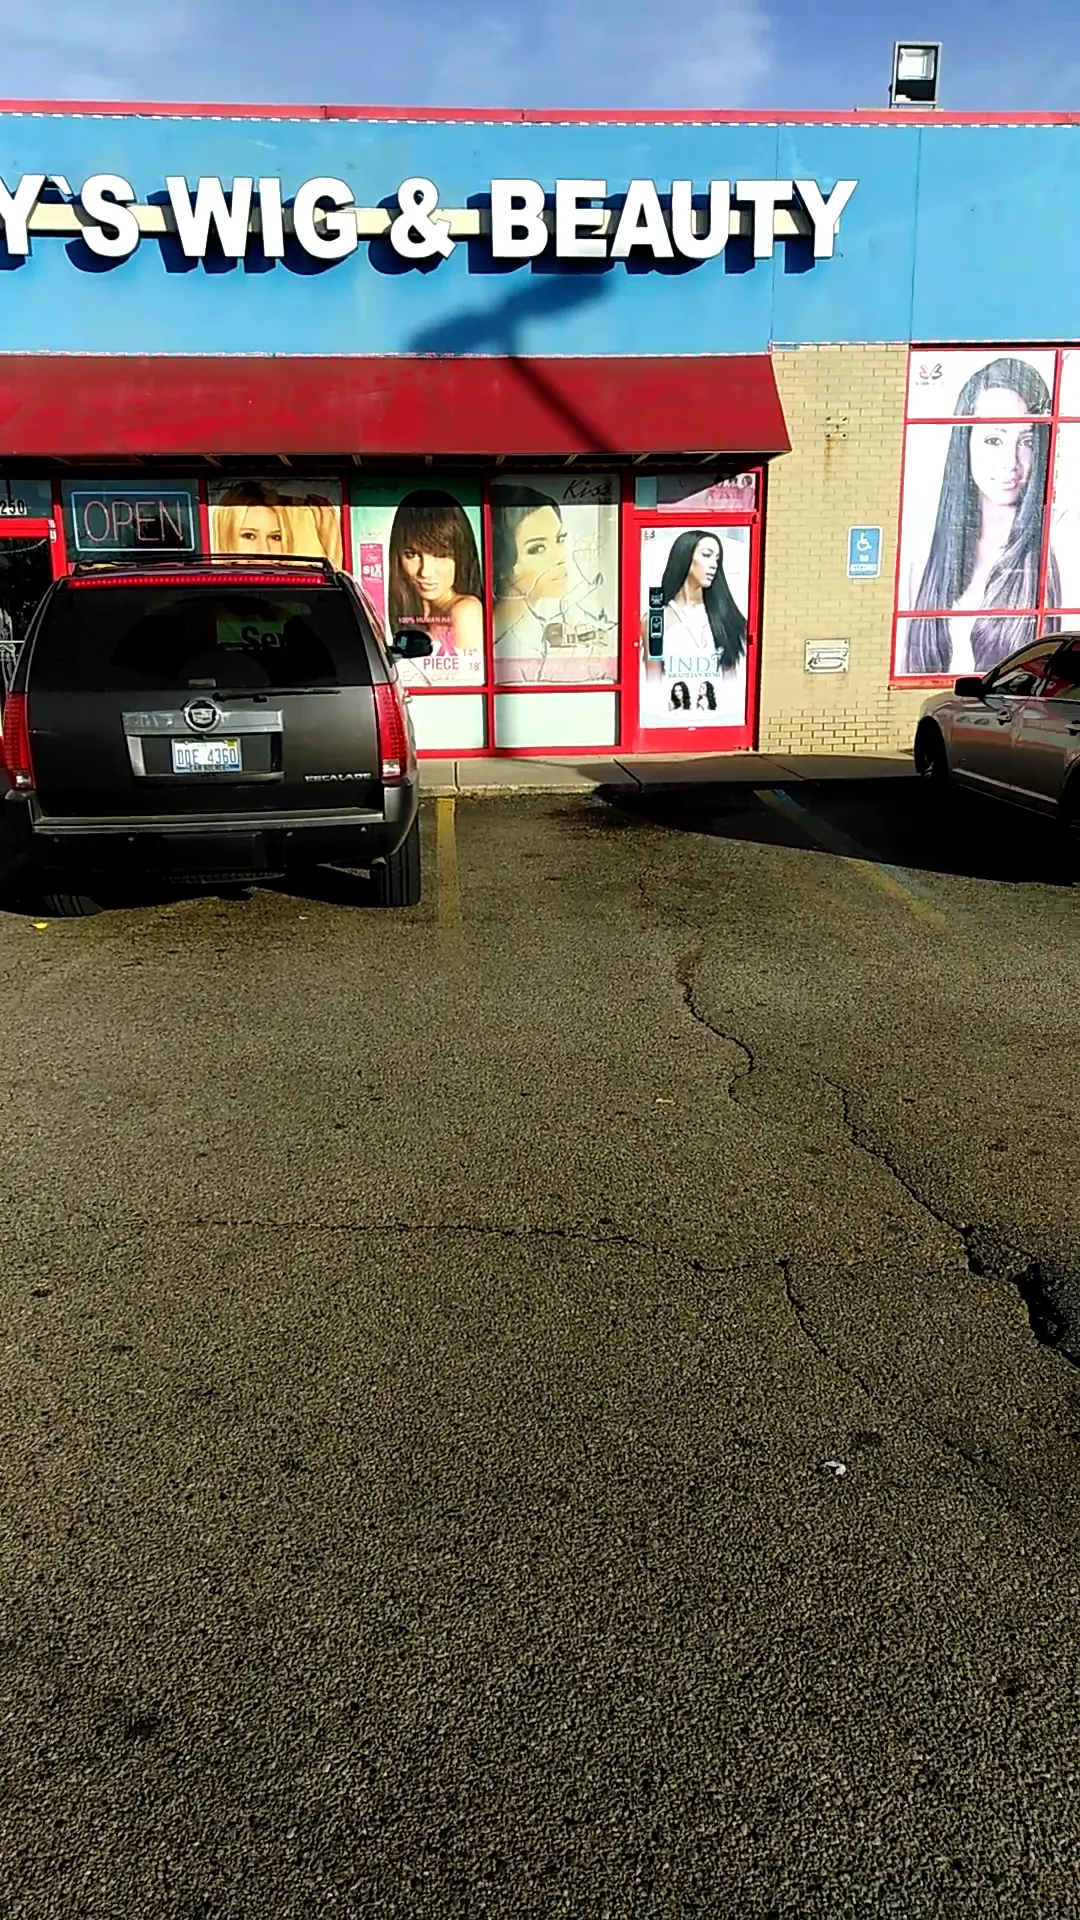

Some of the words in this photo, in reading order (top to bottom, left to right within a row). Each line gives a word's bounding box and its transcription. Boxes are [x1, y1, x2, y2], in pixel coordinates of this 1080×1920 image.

[165, 176, 359, 260] WIG
[390, 177, 457, 260] &
[490, 178, 859, 259] BEAUTY
[83, 500, 184, 541] OPEN
[423, 657, 460, 670] PIECE
[207, 747, 237, 765] 4360
